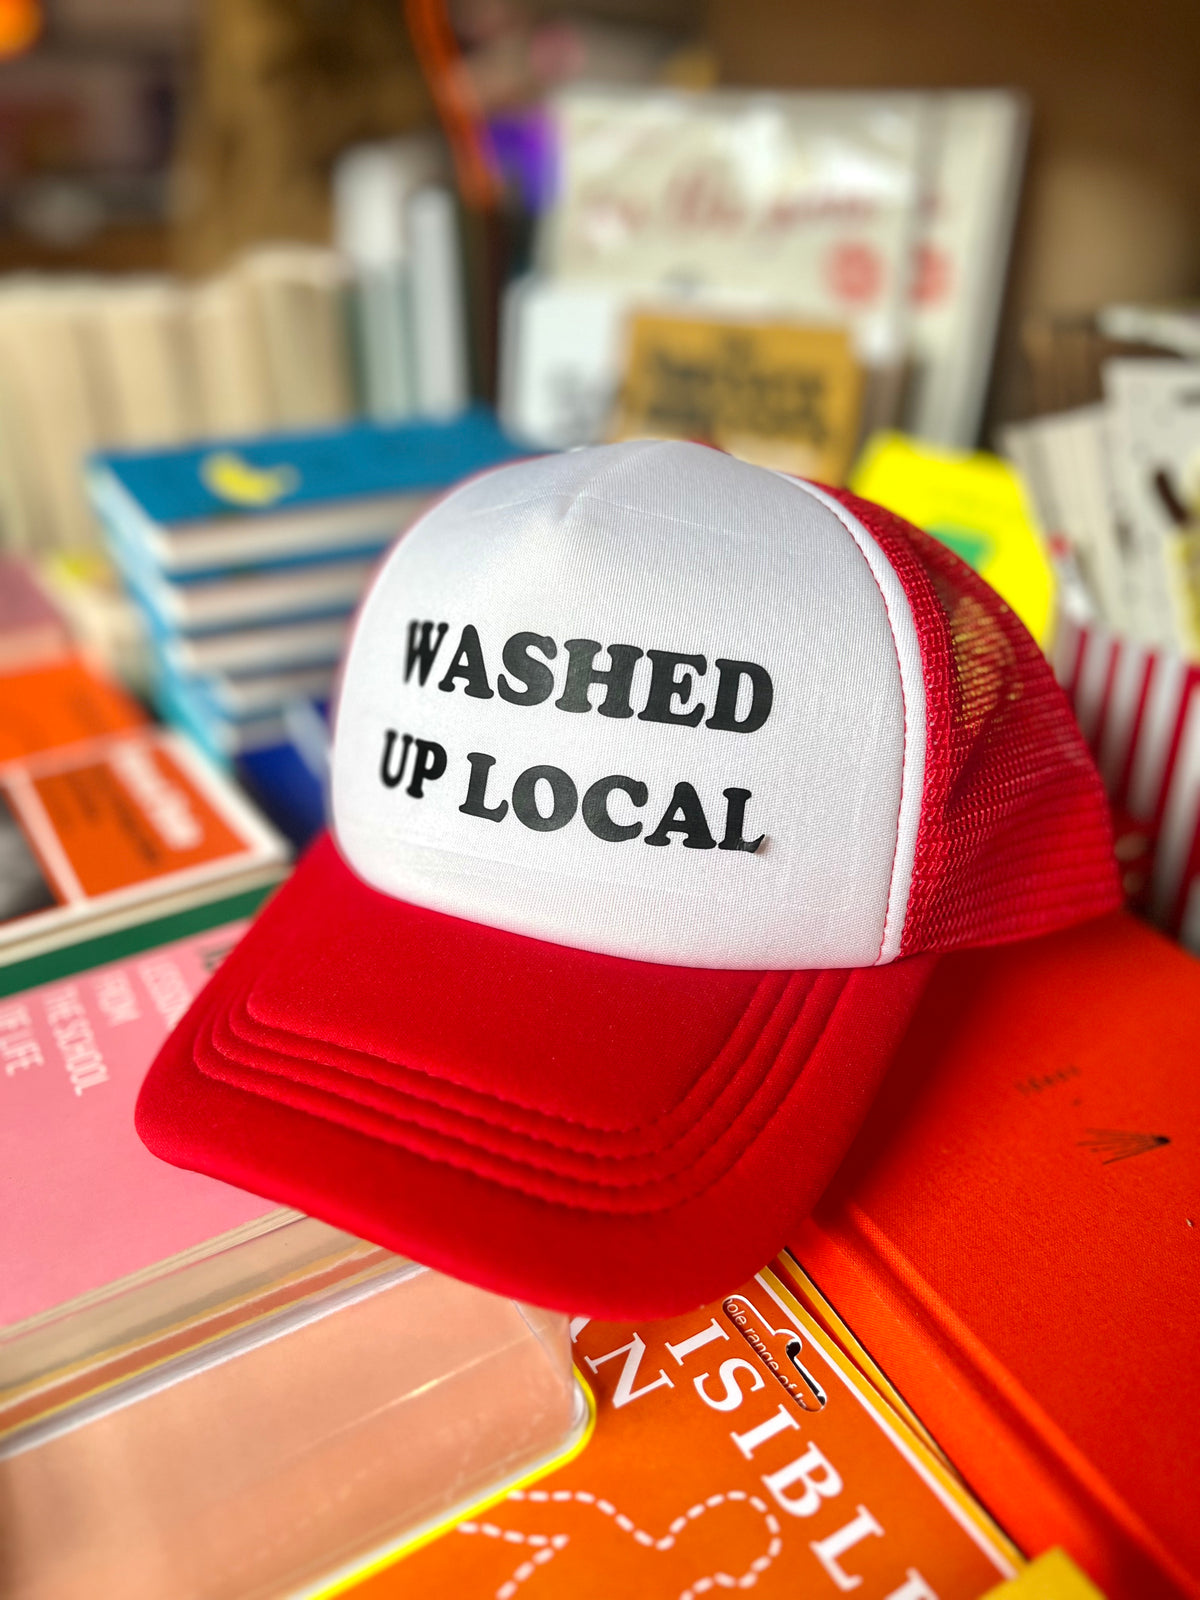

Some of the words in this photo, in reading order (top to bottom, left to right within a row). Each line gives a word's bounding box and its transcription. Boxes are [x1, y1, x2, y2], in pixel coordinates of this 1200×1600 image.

[404, 619, 773, 733] WASHED
[379, 728, 447, 799] UP
[459, 752, 766, 853] LOCAL
[41, 986, 87, 1026] THE
[0, 1028, 45, 1077] LIFE
[51, 1016, 110, 1096] SCHOOL
[744, 1327, 780, 1371] range
